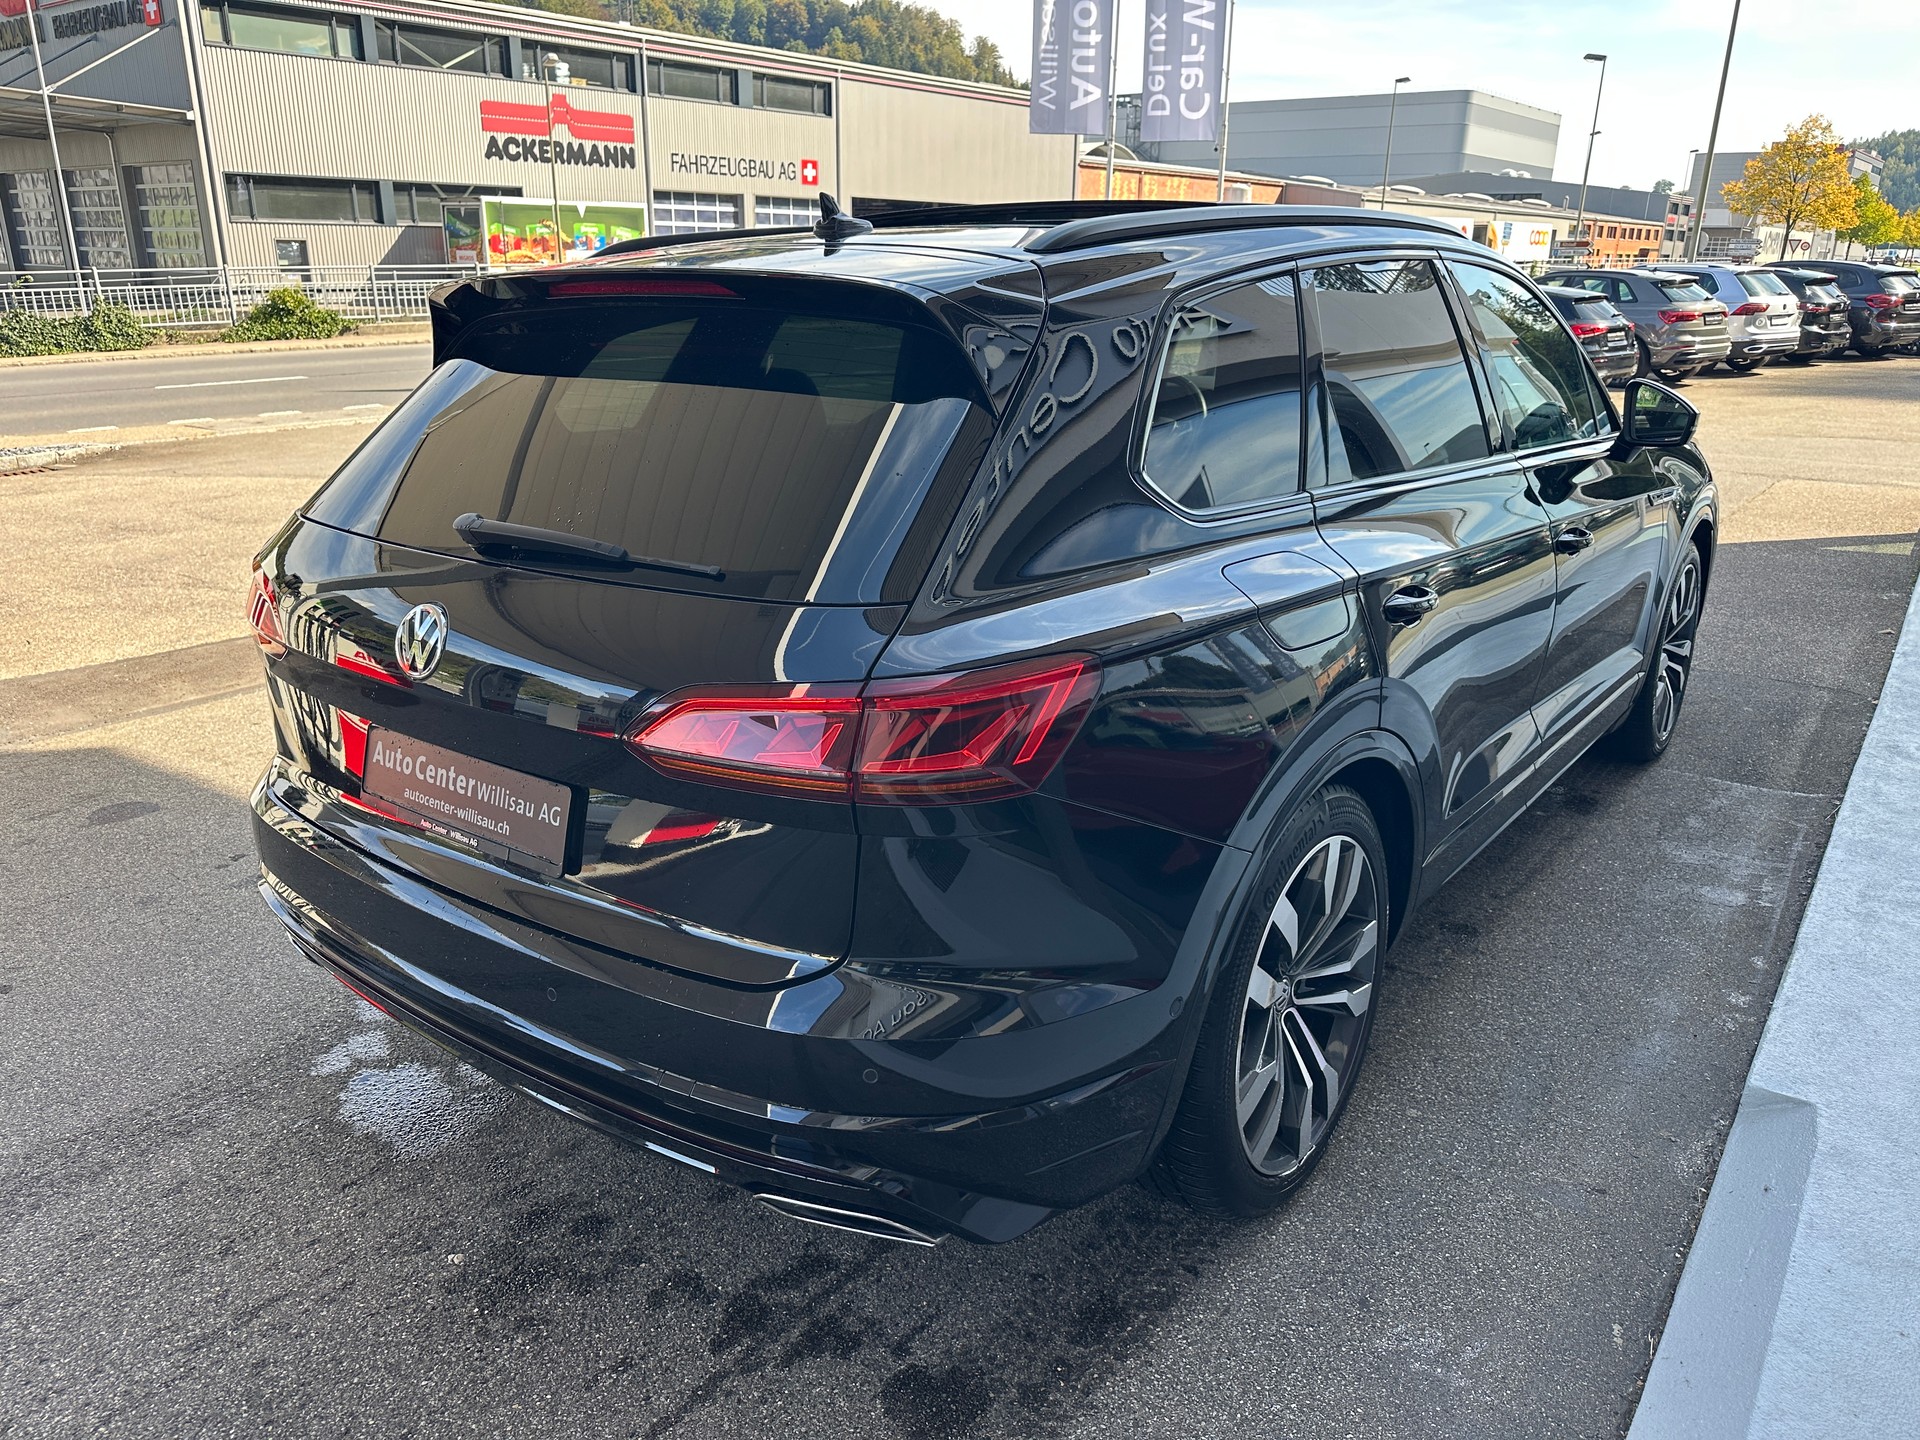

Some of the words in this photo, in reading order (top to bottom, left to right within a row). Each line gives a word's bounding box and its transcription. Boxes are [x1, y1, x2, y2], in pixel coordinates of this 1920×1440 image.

[485, 135, 636, 169] ACKERMANN
[671, 153, 775, 180] FAHRZEUGBAU
[779, 161, 797, 181] AG
[404, 787, 510, 836] autocenter-willisau.ch
[538, 802, 561, 827] AG
